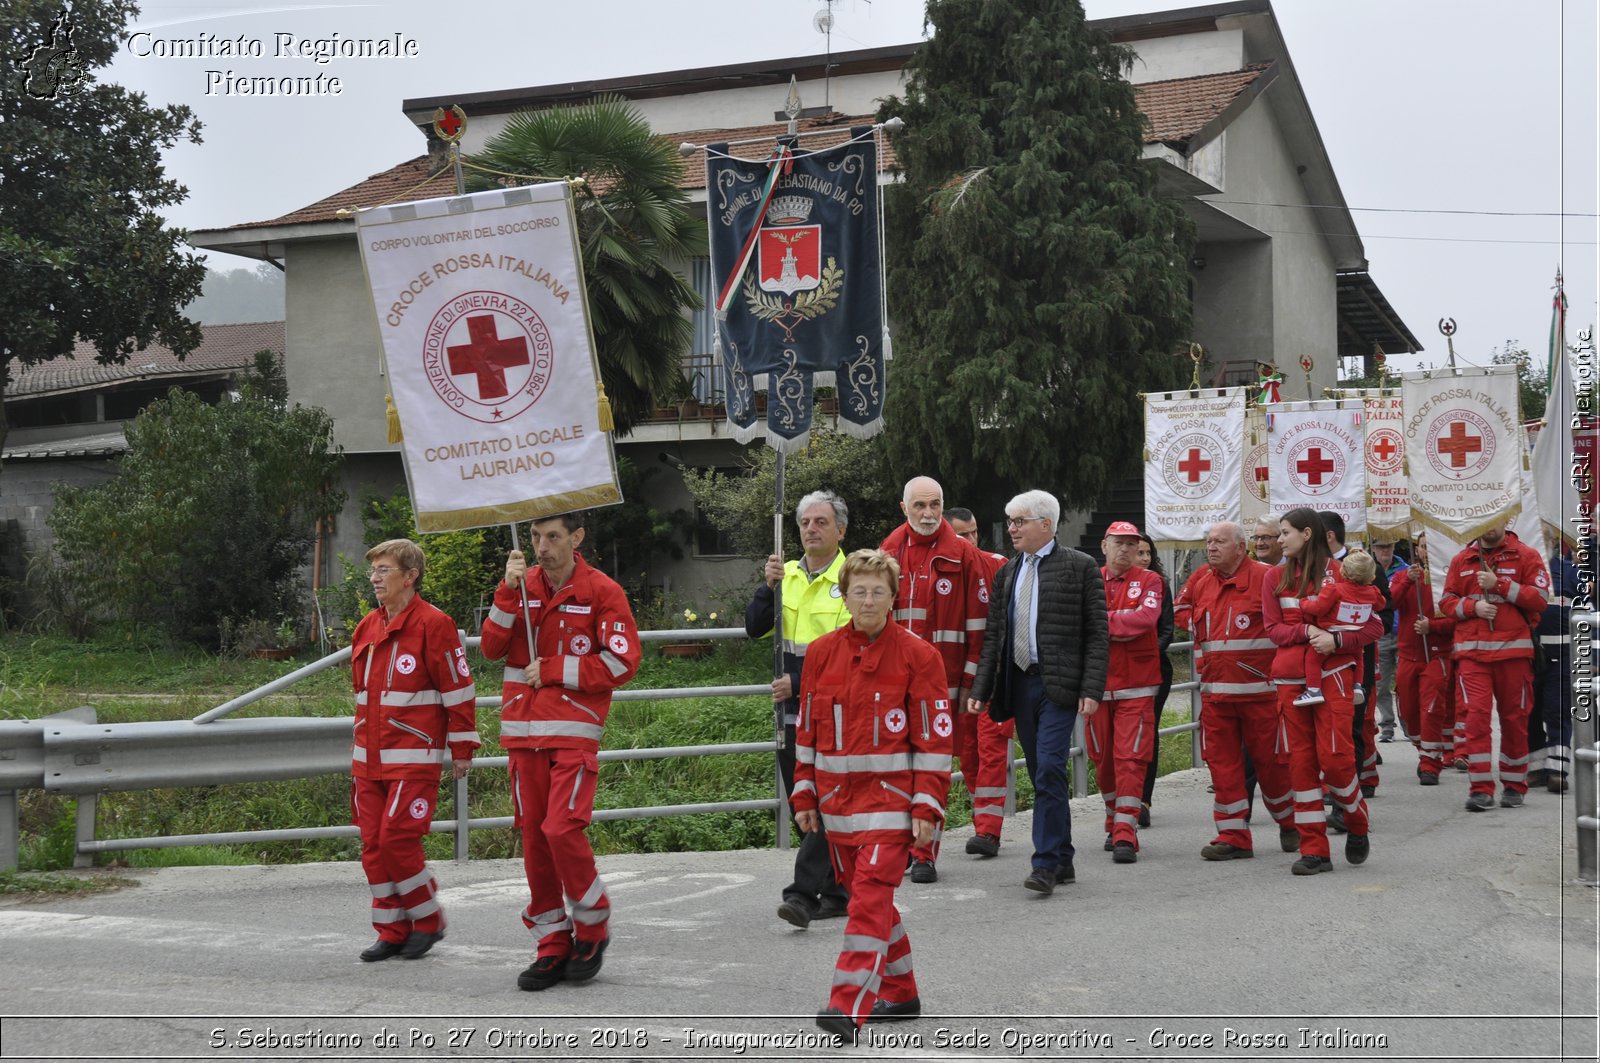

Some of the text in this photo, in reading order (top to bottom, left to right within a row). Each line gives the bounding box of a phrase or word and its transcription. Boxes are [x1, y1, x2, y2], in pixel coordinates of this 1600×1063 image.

[721, 192, 751, 226] COMUNE
[752, 187, 762, 200] DI
[832, 186, 848, 203] DA
[847, 198, 863, 215] PO
[371, 216, 560, 252] CORPO VOLONTARI DEL SOCCORSO
[386, 253, 570, 327] CROCE ROSSA ITALIANA
[426, 296, 549, 408] CONVENZIONE DI GINEVRA 22 AGOSTO 1864
[1364, 400, 1386, 408] OCE
[1366, 412, 1403, 420] TALIAN
[1407, 389, 1514, 438] CROCE ROSSA ITALIANA
[424, 425, 585, 462] COMITATO LOCALE
[1152, 419, 1234, 461] CROCE ROSSA ITALIANA
[1180, 435, 1208, 447] GINEVRA
[1208, 442, 1217, 452] 22
[1275, 430, 1295, 455] CROCE
[1295, 421, 1321, 433] ROSSA
[1324, 422, 1358, 453] ITALIANA
[1439, 417, 1446, 425] DI
[1445, 411, 1475, 421] GINEVRA
[1475, 417, 1485, 426] 22
[1482, 425, 1494, 455] AGOSTO
[460, 452, 555, 480] LAURIANO
[1411, 490, 1514, 517] GASSINO TORINESE
[1421, 482, 1504, 492] COMITATO LOCALE
[1156, 503, 1228, 512] COMITATO LOCALE
[1316, 502, 1349, 510] LOCALE
[1351, 501, 1360, 509] DI
